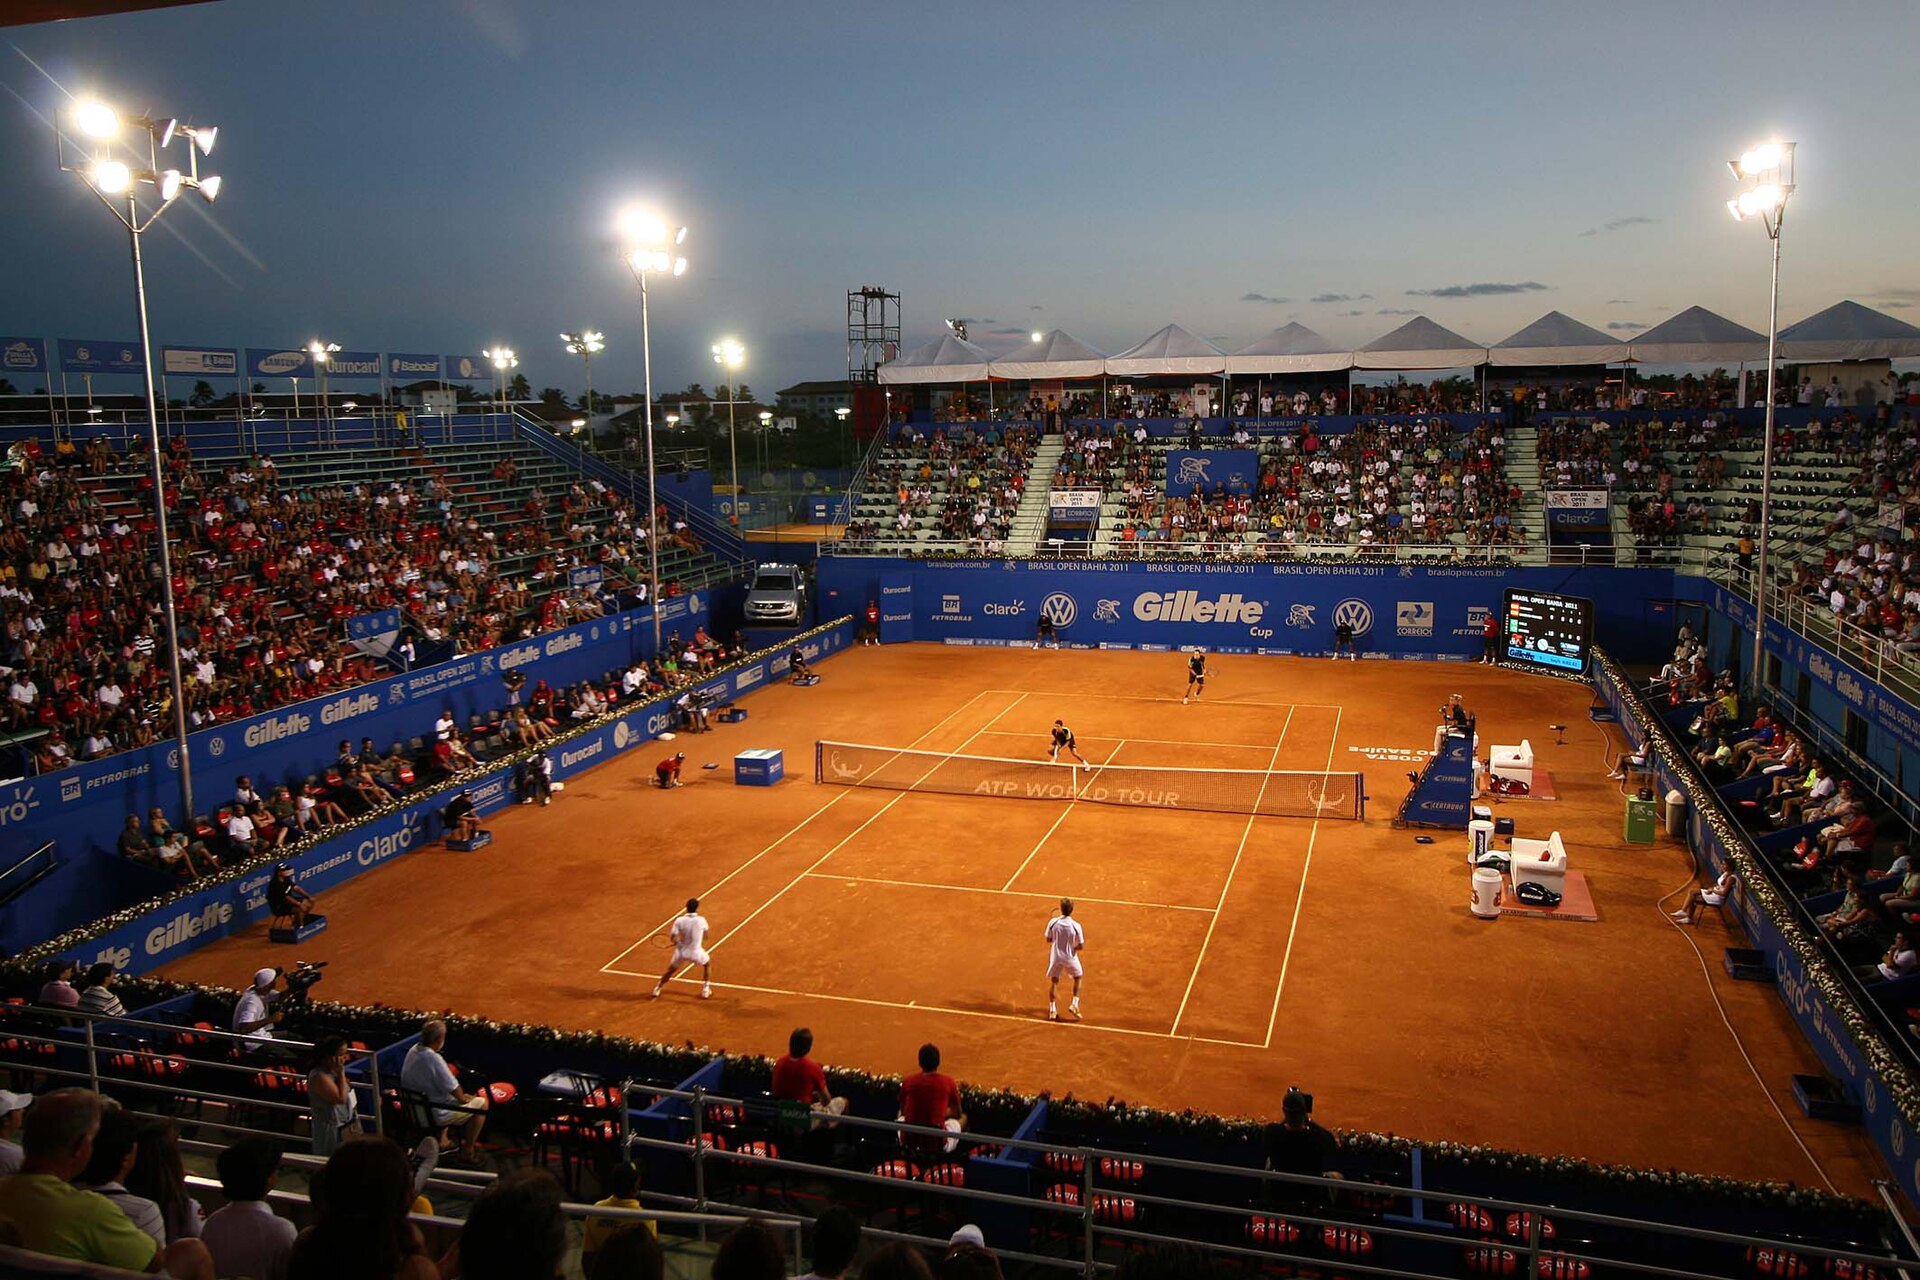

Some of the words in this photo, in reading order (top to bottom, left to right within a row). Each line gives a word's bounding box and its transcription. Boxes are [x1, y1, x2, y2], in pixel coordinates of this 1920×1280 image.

[326, 356, 381, 374] Ourocard
[401, 360, 439, 372] Babolat
[1557, 512, 1591, 524] Claro
[1028, 562, 1056, 572] BRASIL
[1057, 562, 1080, 572] OPEN
[1081, 563, 1108, 573] BAHIA
[1109, 563, 1130, 573] 2011
[1146, 564, 1175, 573] BRASIL
[1177, 565, 1201, 573] OPEN
[1205, 565, 1232, 574] BAHIA
[1234, 565, 1255, 574] 2011
[1273, 566, 1303, 575] BRASIL
[1305, 566, 1330, 575] OPEN
[1332, 567, 1361, 576] BAHIA
[1363, 567, 1385, 576] 2011
[1427, 568, 1506, 579] brasilopen.com.br
[984, 603, 1020, 615] Claro
[1133, 590, 1263, 624] Gillette
[1511, 593, 1529, 603] BRASIL
[1530, 597, 1545, 606] OPEN
[1546, 599, 1564, 608] BAHIA
[1564, 602, 1579, 611] 2011
[546, 631, 583, 656] Gillette
[1250, 626, 1273, 639] Cup
[1396, 627, 1433, 636] CORREIOS
[499, 645, 541, 670] Gillette
[1509, 648, 1536, 661] Gillette
[409, 673, 437, 690] BRASIL
[437, 667, 459, 681] OPEN
[458, 661, 476, 675] 2011
[1836, 671, 1864, 706] Gillette
[320, 694, 379, 725] Gillette
[244, 713, 310, 748] Gillette
[561, 737, 603, 768] Ourocard
[1365, 753, 1424, 762] COSTA
[86, 763, 151, 790] PETROBRAS
[975, 779, 1018, 796] ATP
[1026, 782, 1108, 801] WORLD
[1118, 788, 1180, 806] TOUR
[356, 824, 413, 867] Claro
[299, 851, 352, 881] PETROBRAS
[144, 901, 234, 956] Gillette
[1776, 949, 1805, 1015] Claro
[1824, 1023, 1857, 1078] PETROBRAS
